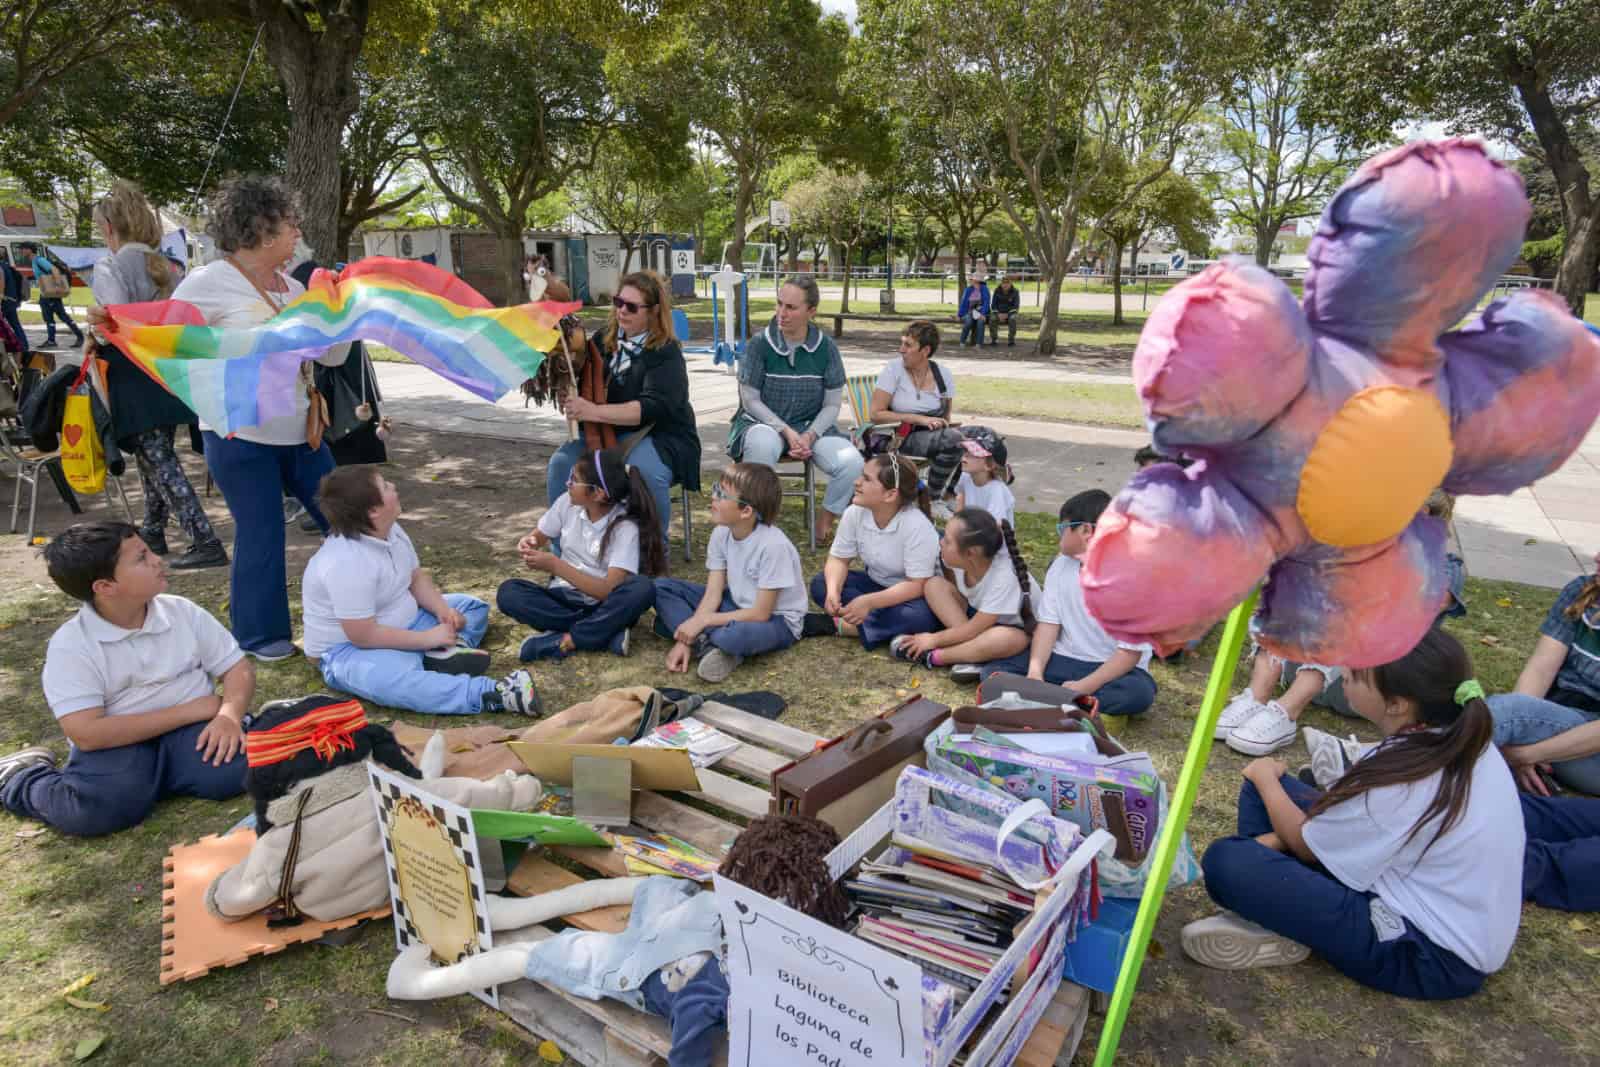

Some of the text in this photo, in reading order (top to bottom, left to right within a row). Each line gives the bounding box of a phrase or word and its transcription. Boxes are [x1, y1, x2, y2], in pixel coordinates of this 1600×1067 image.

[778, 969, 870, 1025] Biblioteca
[775, 994, 873, 1058] Laguna de
[776, 1023, 845, 1067] los Pad
